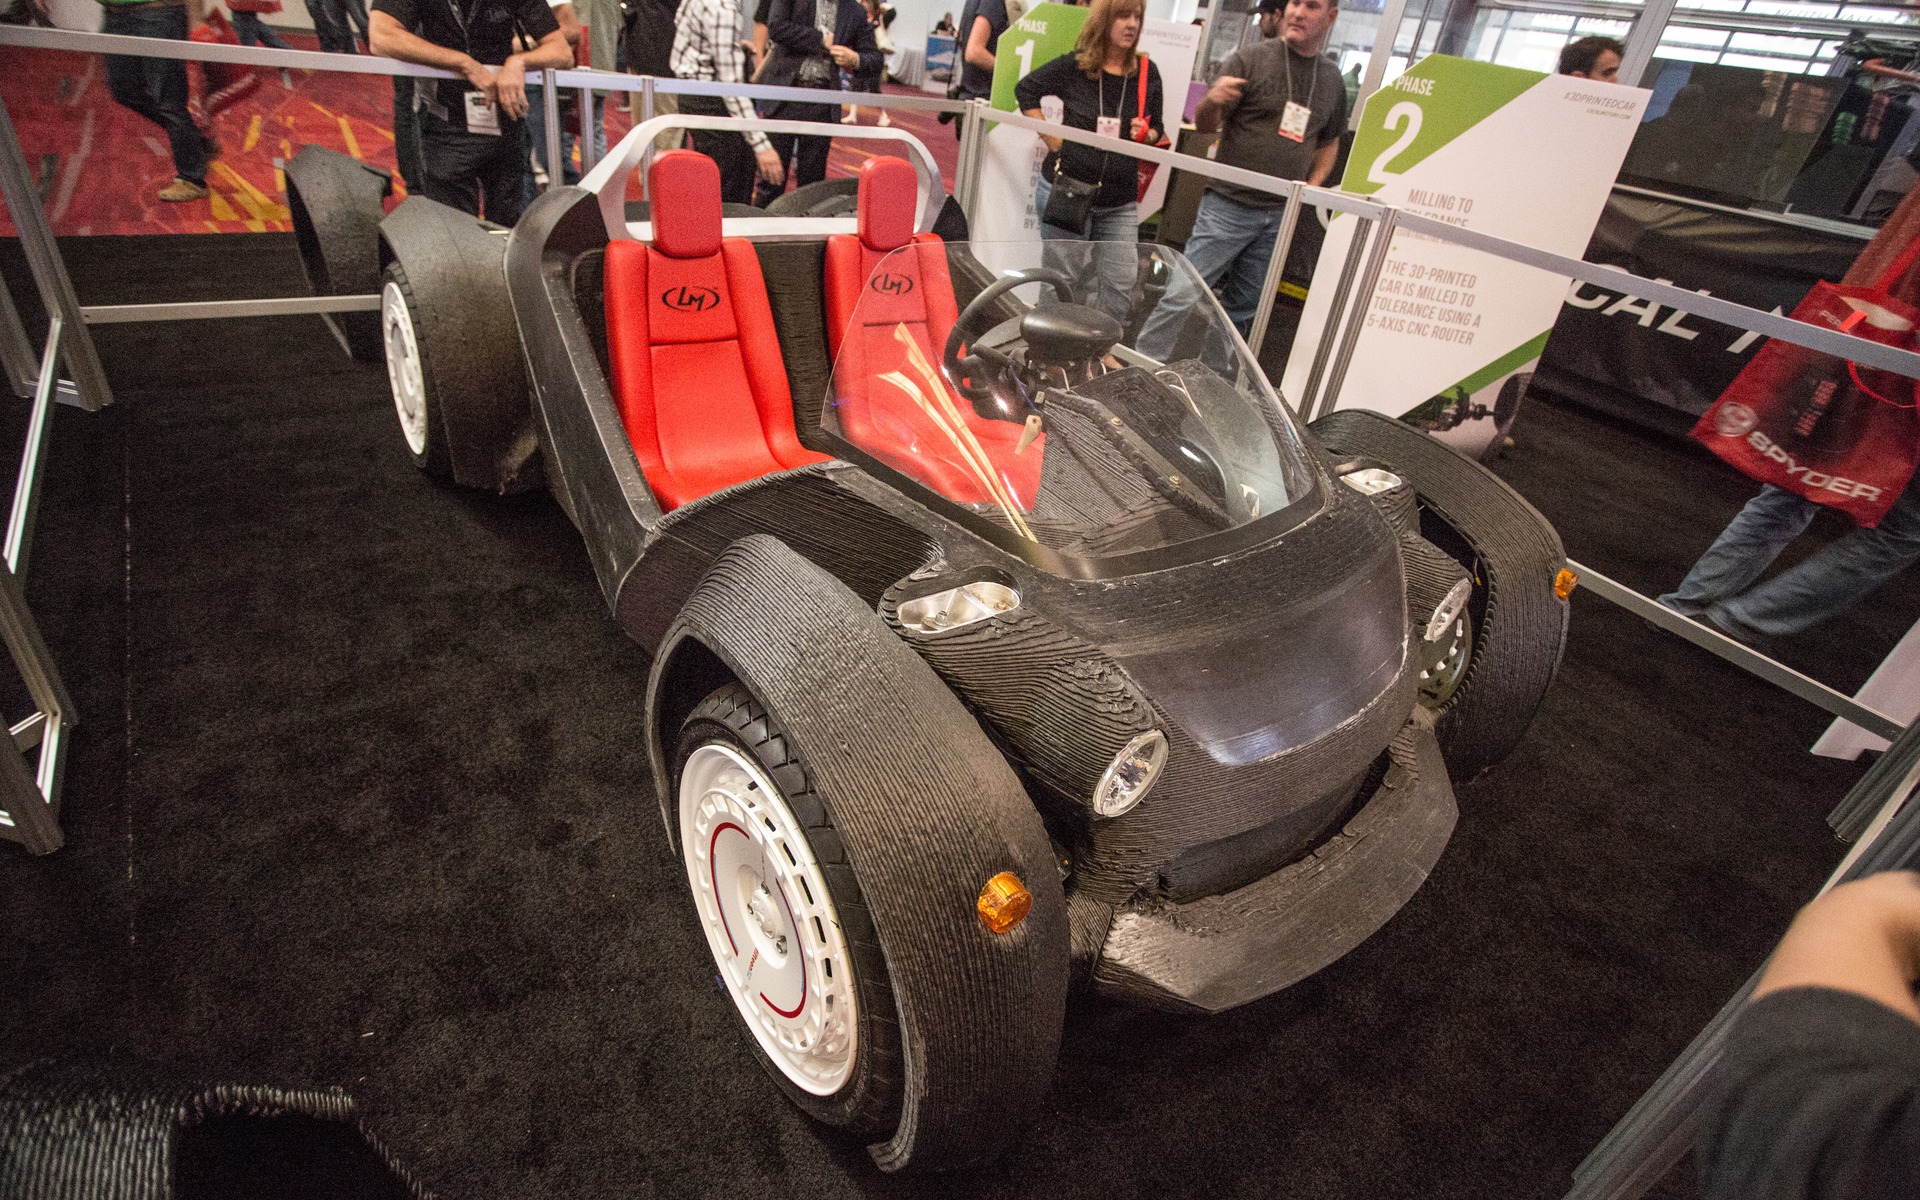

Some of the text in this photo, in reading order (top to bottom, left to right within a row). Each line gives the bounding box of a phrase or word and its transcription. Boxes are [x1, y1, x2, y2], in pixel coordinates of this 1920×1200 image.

[1018, 18, 1048, 35] PHASE
[1015, 39, 1035, 80] 1
[1395, 75, 1436, 96] PHASE
[1563, 91, 1637, 111] #3DPRINTEDCAR
[1367, 101, 1424, 185] 2
[1407, 189, 1474, 214] MILLING TO
[1385, 259, 1478, 289] THE 3D-PRINTED
[1378, 277, 1476, 309] CAR IS MILLED TO
[1373, 295, 1482, 329] TOLERANCE USING A
[1367, 313, 1476, 346] 5-AXIS CNC ROUTER
[1747, 430, 1883, 502] SPYDER
